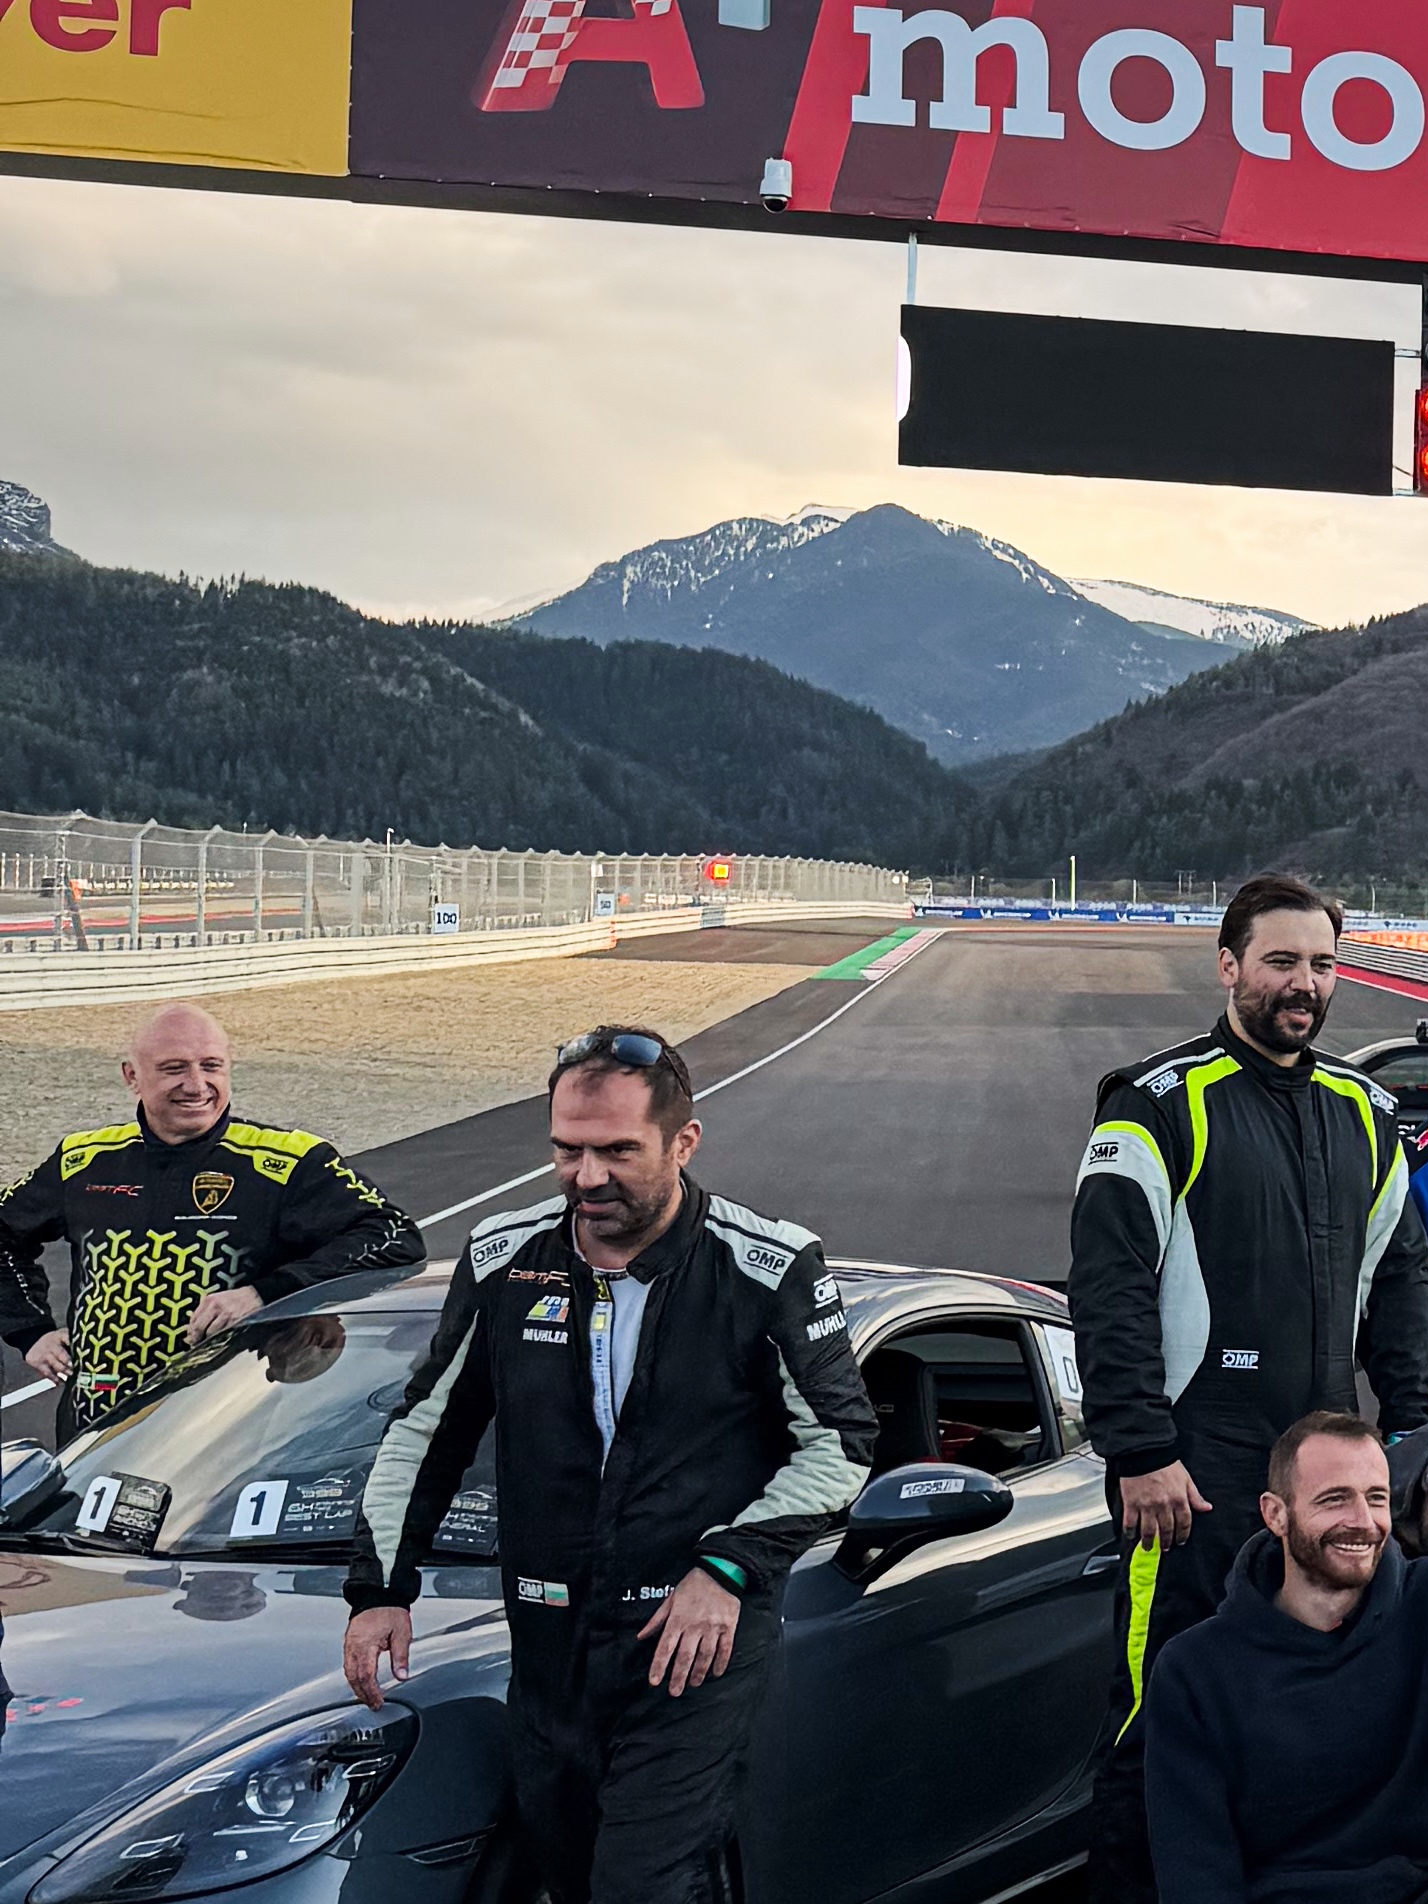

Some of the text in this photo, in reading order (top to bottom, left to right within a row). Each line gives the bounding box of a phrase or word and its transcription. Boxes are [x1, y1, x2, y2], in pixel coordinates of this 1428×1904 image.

[436, 912, 458, 925] 100
[472, 1239, 509, 1263] OMP
[746, 1249, 786, 1270] OMP
[1222, 1352, 1259, 1366] OMP
[89, 1486, 107, 1520] 1
[249, 1490, 268, 1526] 1
[621, 1588, 637, 1602] J.
